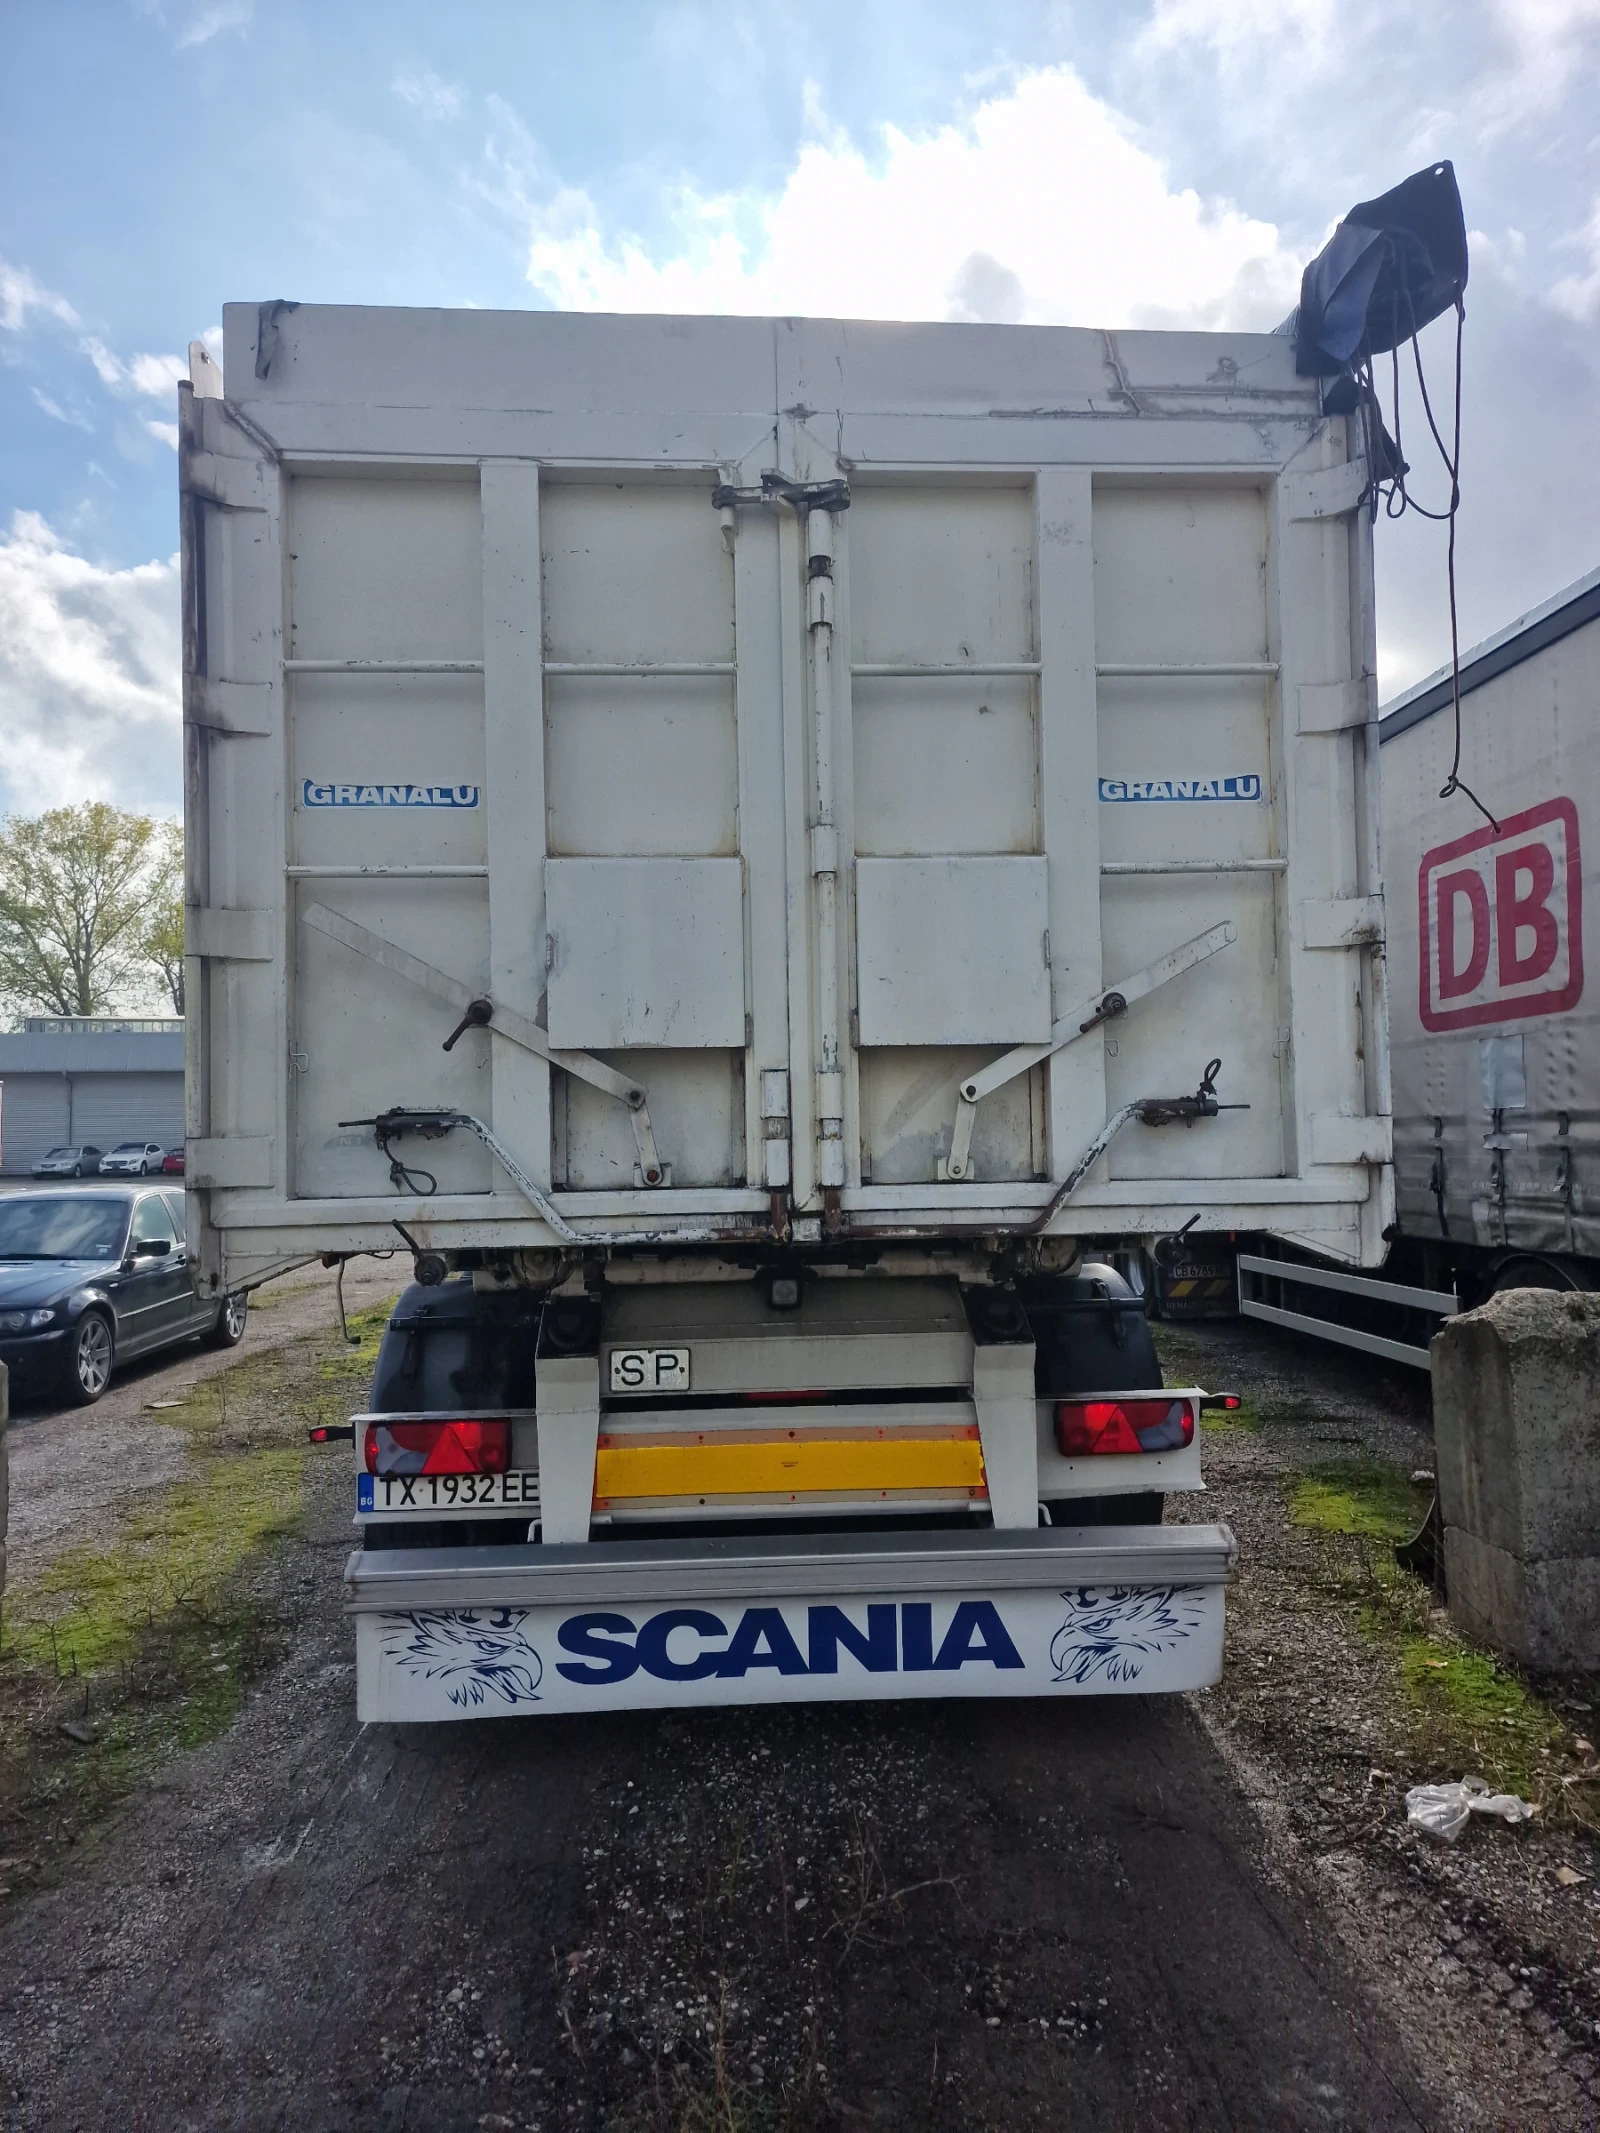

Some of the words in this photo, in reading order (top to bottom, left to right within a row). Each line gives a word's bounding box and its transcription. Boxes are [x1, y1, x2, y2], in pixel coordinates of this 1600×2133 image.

[307, 785, 475, 805] GRANALU
[1101, 778, 1258, 800] GRANALU
[1436, 842, 1559, 1001] DB
[621, 1354, 679, 1386] SP
[360, 1497, 373, 1506] BG
[555, 1600, 1026, 1686] SCANIA
